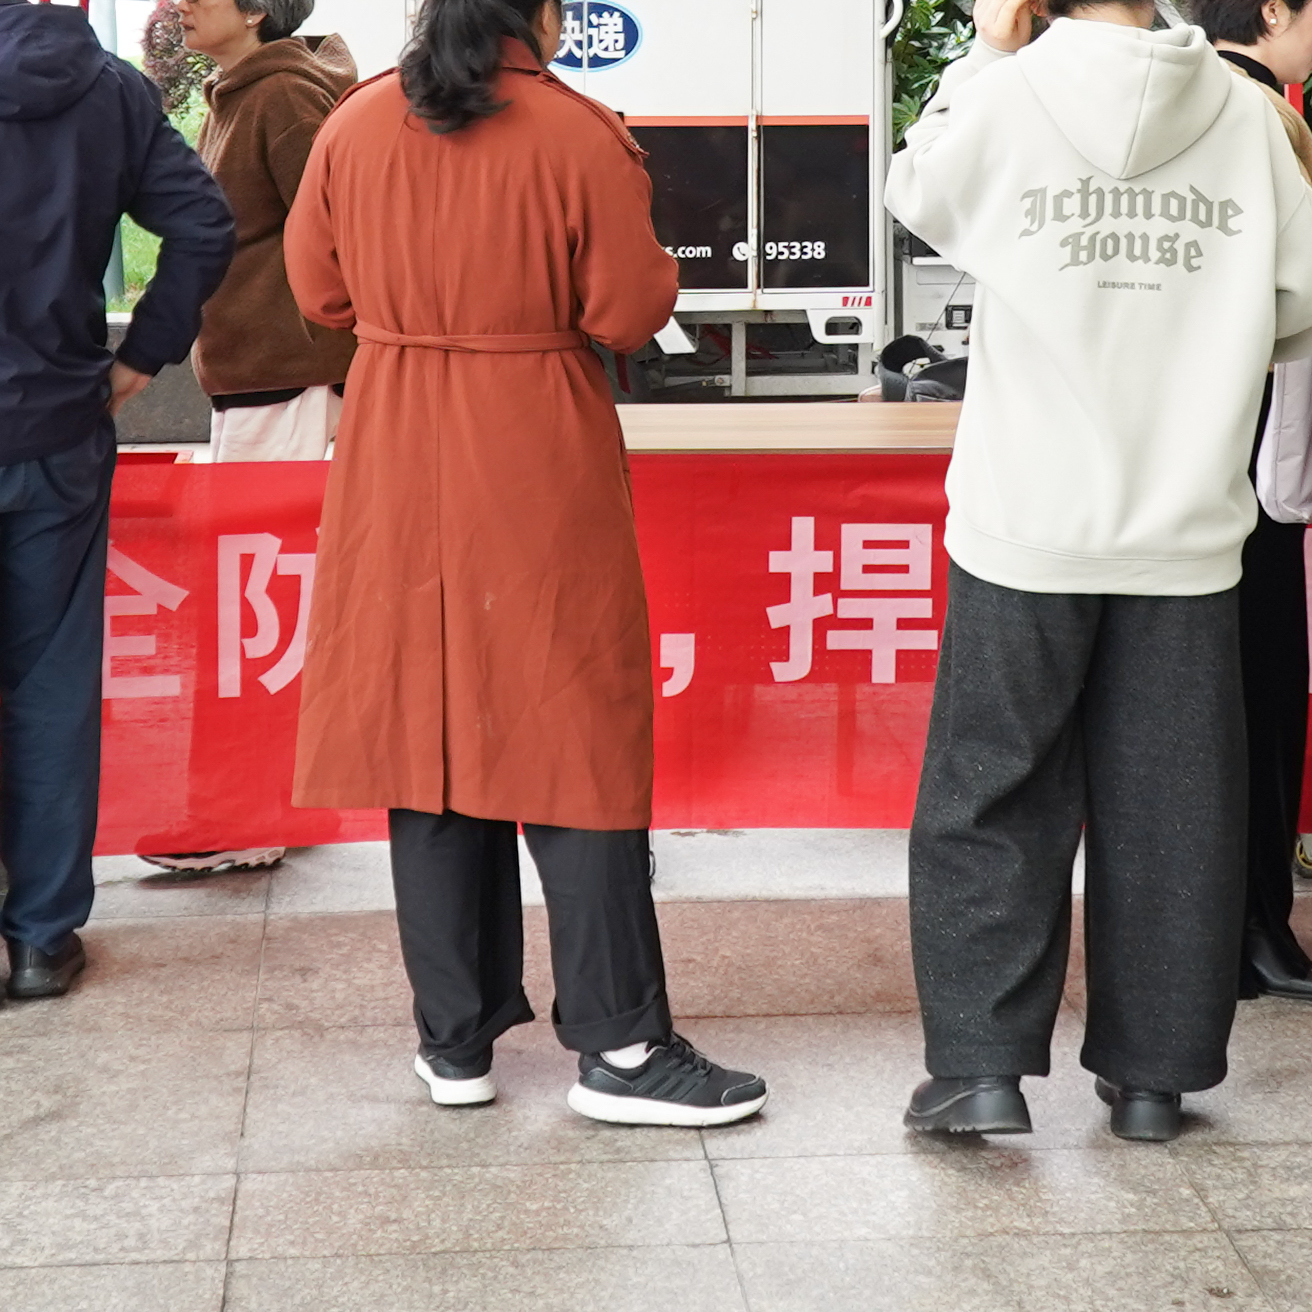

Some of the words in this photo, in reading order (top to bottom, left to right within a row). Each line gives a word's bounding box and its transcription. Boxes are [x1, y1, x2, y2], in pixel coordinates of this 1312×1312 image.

[554, 11, 626, 59] 快递
[661, 245, 712, 259] s.com
[764, 241, 826, 260] 95338
[1058, 230, 1204, 273] House
[1097, 280, 1135, 290] LEISURE
[1138, 282, 1162, 291] TIME
